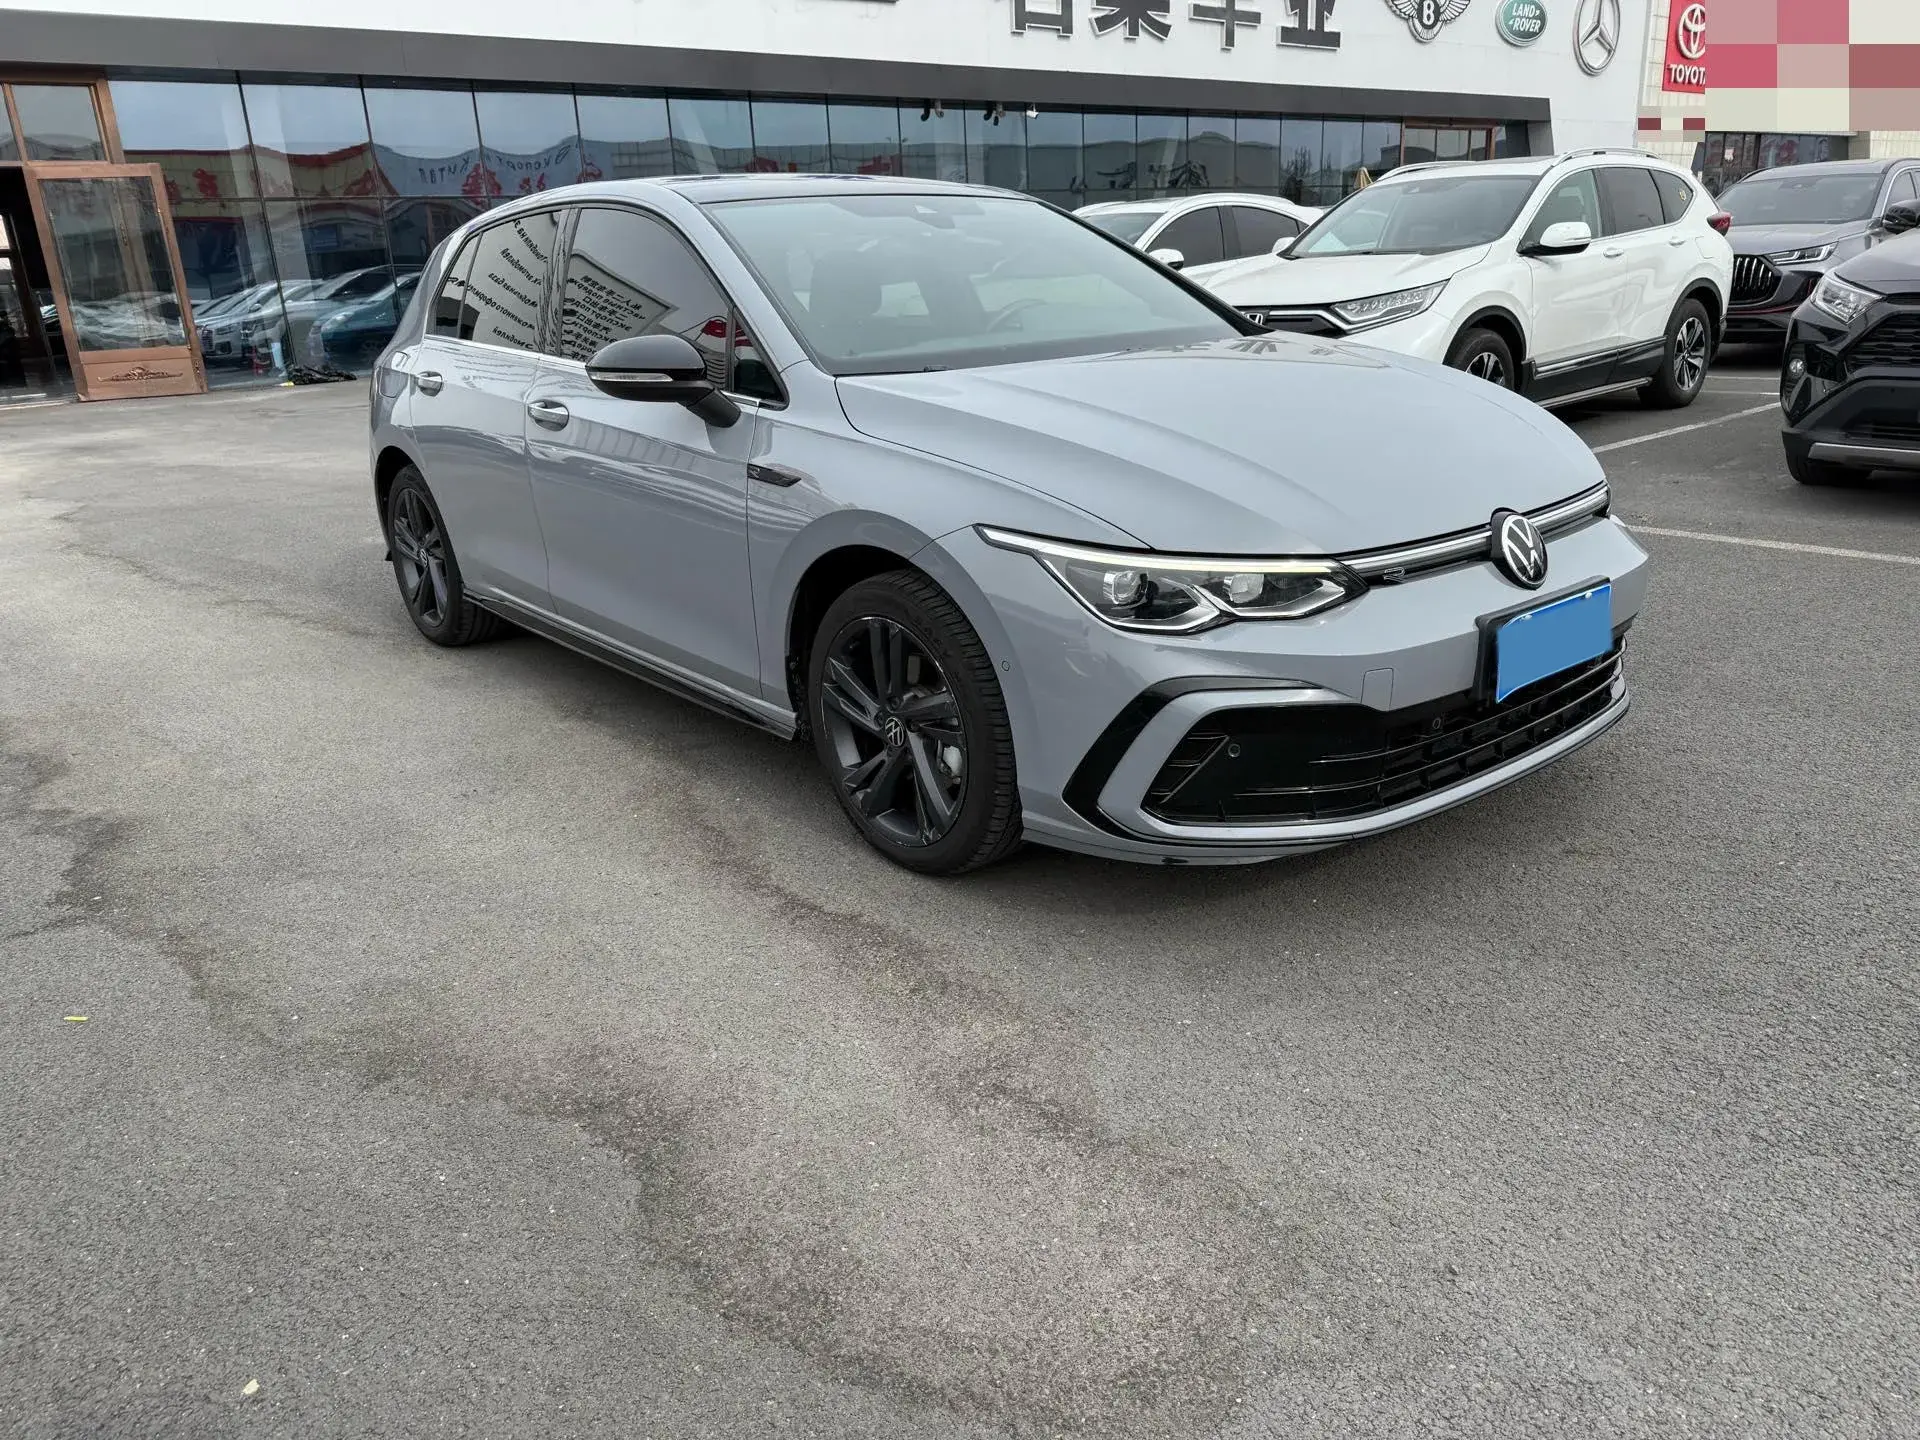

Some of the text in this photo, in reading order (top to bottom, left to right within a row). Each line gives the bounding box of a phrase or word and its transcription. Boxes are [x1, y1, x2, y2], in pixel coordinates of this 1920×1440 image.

[1512, 3, 1535, 17] LAND
[1512, 18, 1541, 32] ROVER
[1669, 63, 1705, 85] TOYOT
